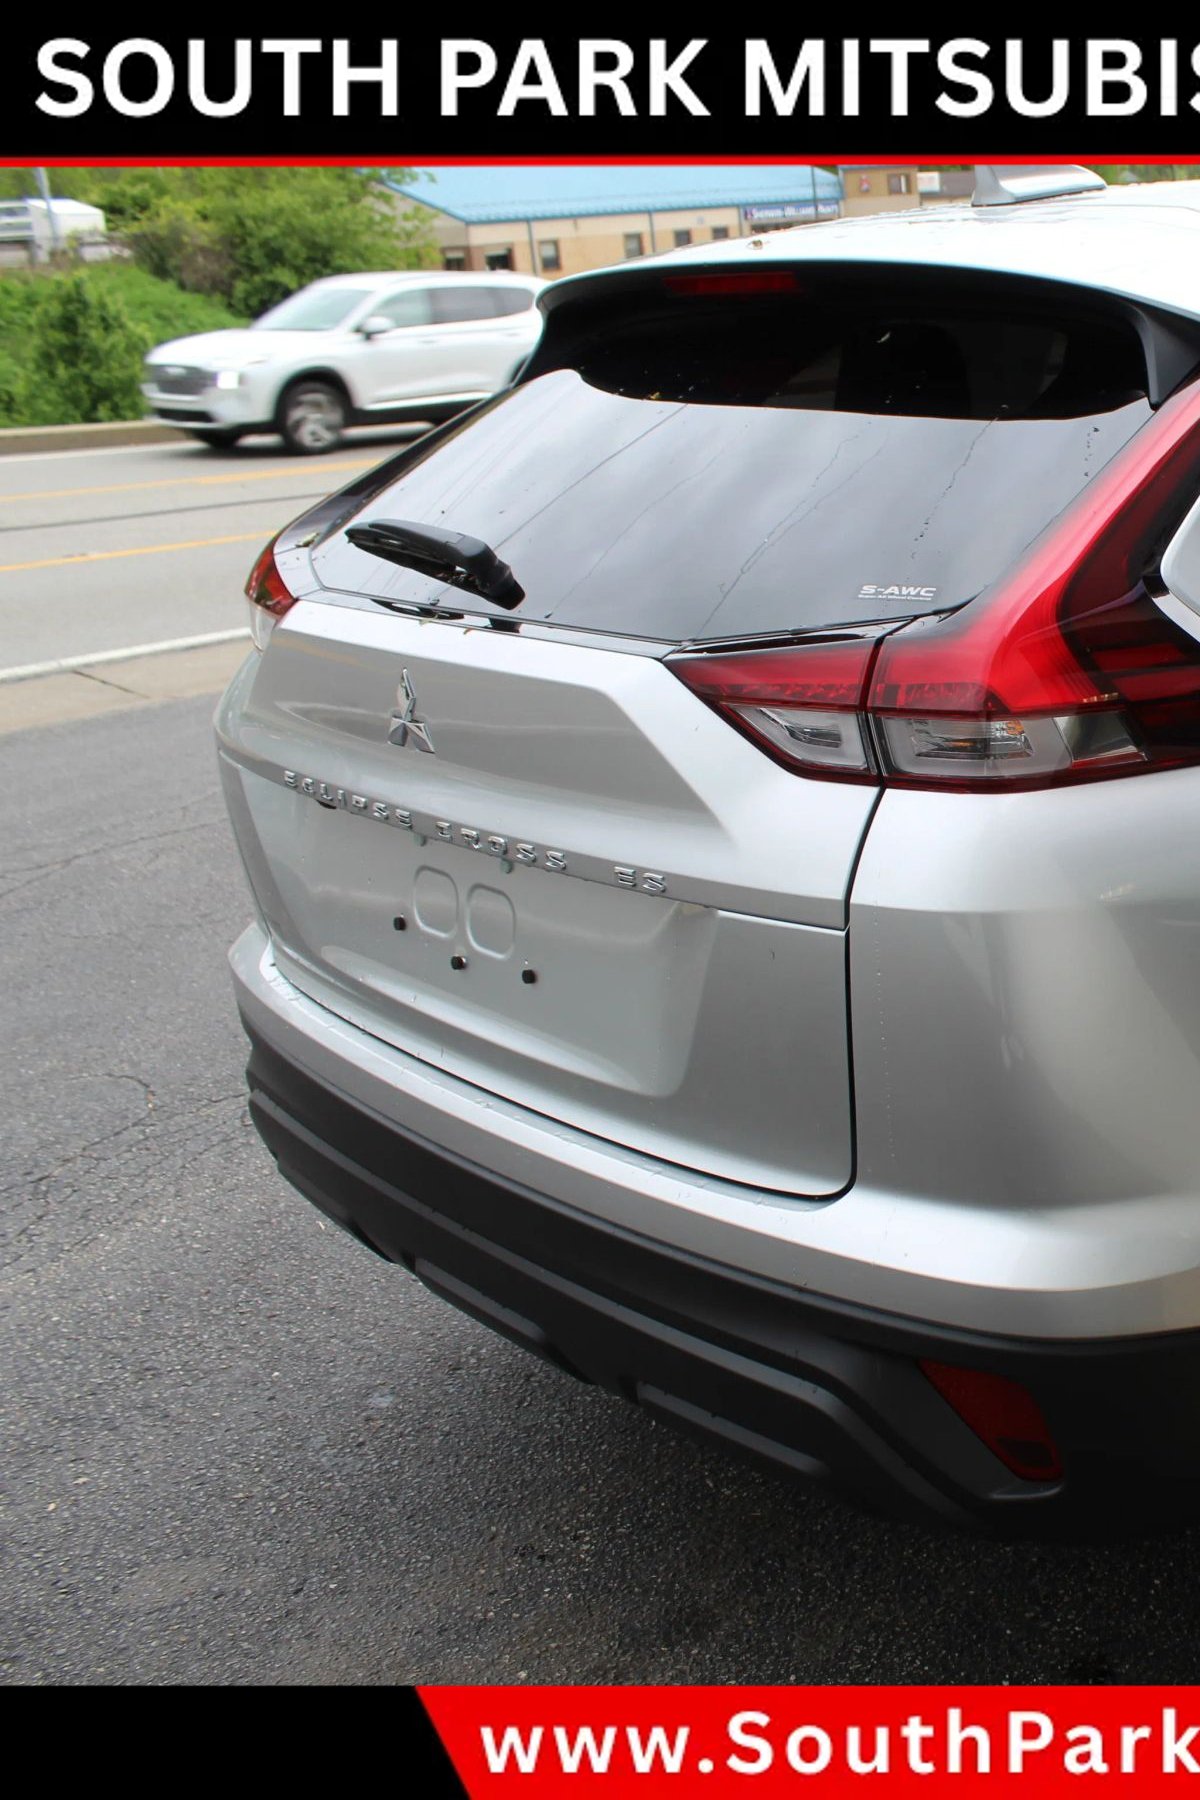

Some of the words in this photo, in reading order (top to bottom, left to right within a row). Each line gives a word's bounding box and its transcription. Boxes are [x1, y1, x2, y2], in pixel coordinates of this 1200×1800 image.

[860, 584, 937, 597] S-AWC
[284, 770, 412, 829] ECLIPSE
[436, 821, 567, 870] CROSS
[614, 866, 667, 893] ES
